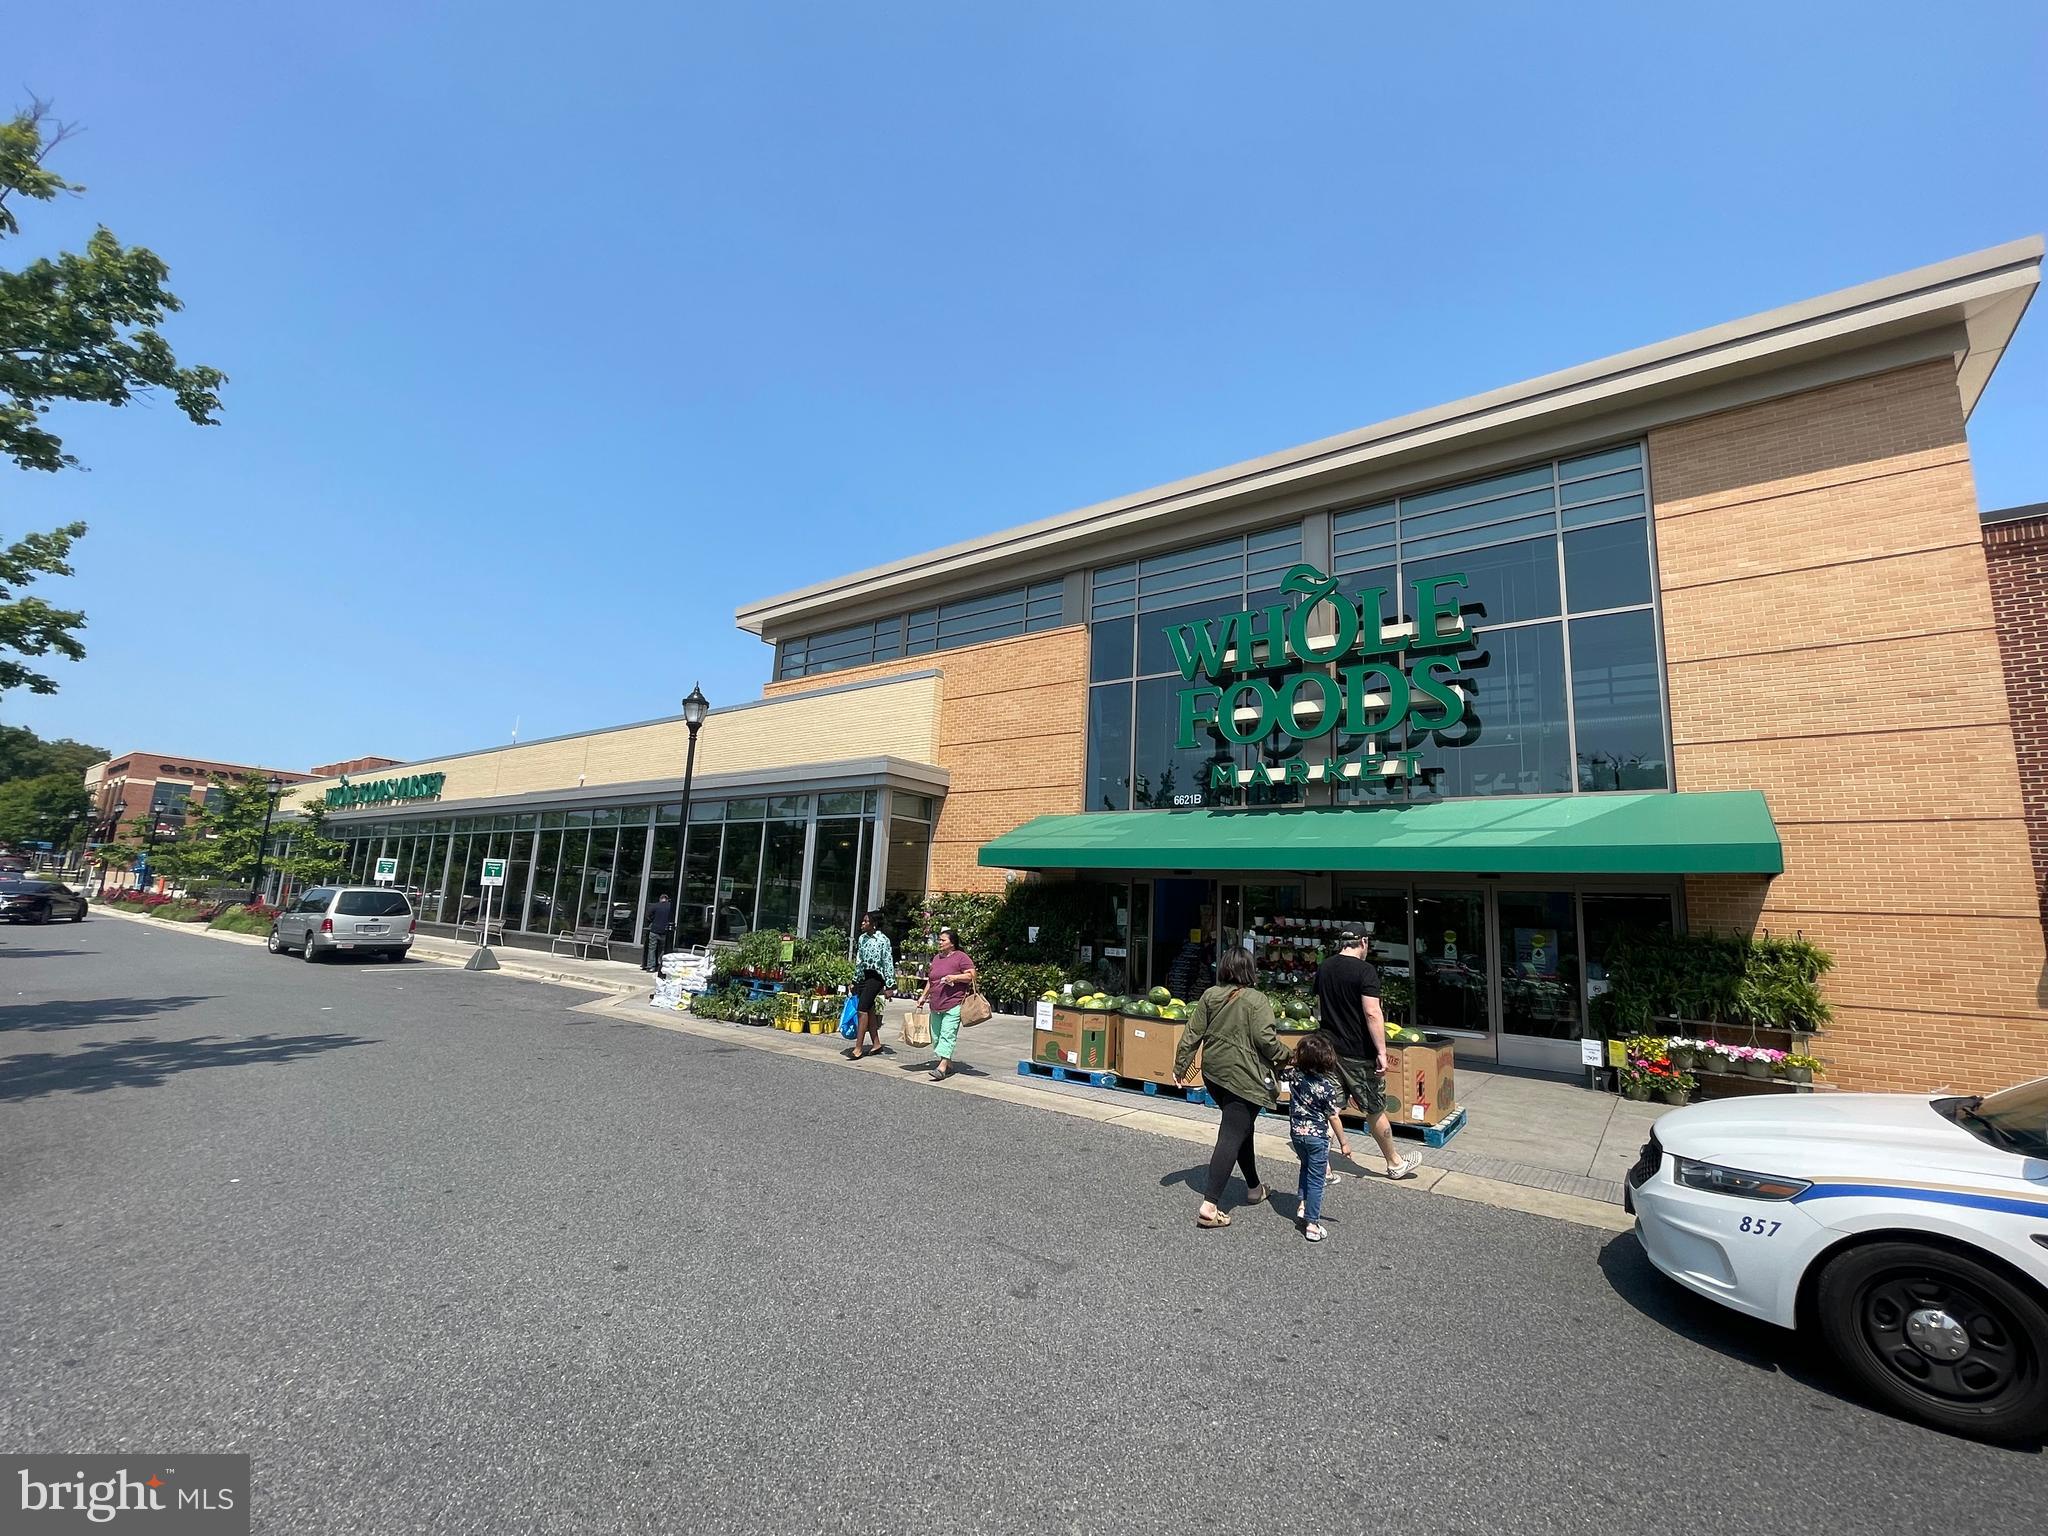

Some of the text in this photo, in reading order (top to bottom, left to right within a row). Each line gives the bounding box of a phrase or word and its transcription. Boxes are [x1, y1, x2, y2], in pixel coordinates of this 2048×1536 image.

[1162, 564, 1473, 681] WHOLE
[1174, 655, 1465, 749] FOODS
[1210, 752, 1424, 789] MARKET
[1174, 794, 1202, 805] 6621B
[1739, 1216, 1782, 1237] 857
